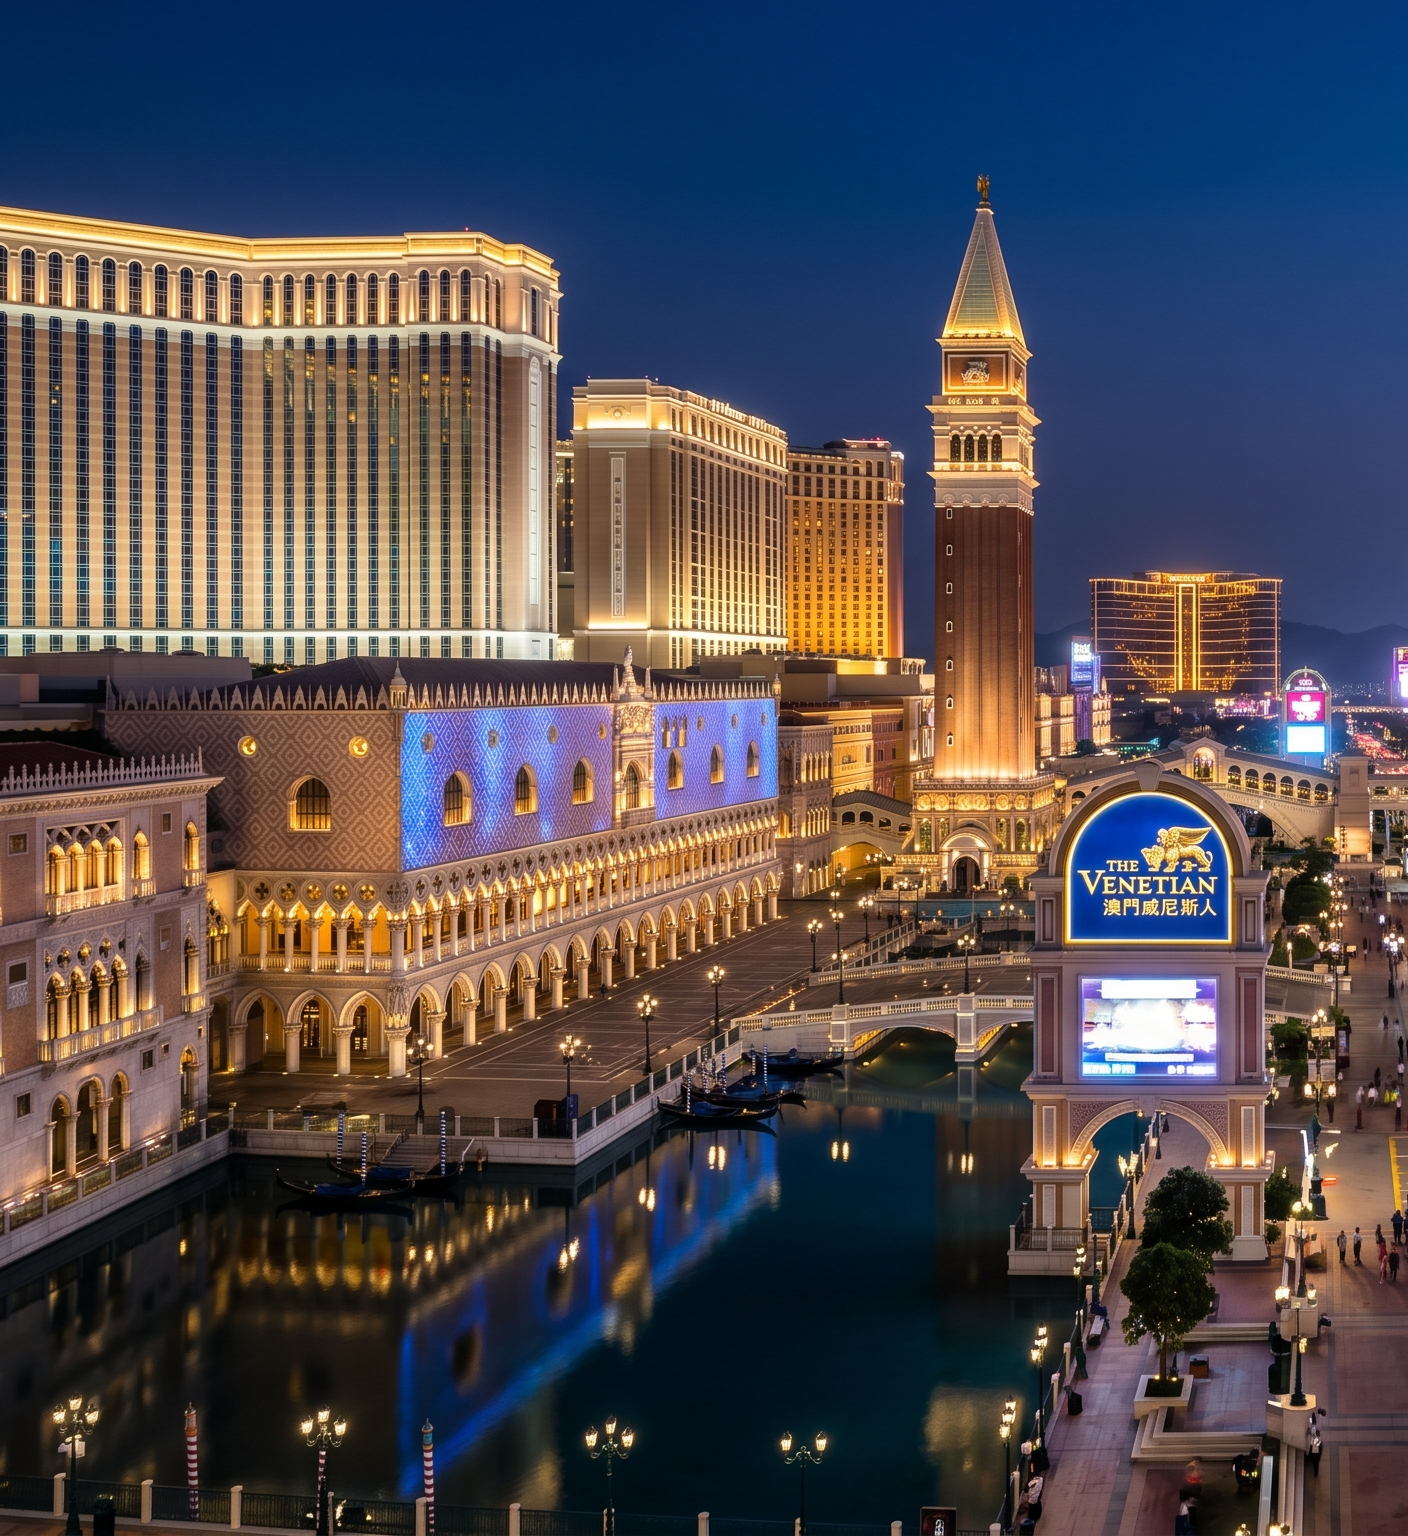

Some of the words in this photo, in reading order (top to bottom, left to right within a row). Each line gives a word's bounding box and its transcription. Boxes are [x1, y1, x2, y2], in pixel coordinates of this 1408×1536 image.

[1106, 860, 1139, 871] THE
[1077, 869, 1218, 895] VENETIAN
[1103, 898, 1217, 917] 澳門威尼斯人
